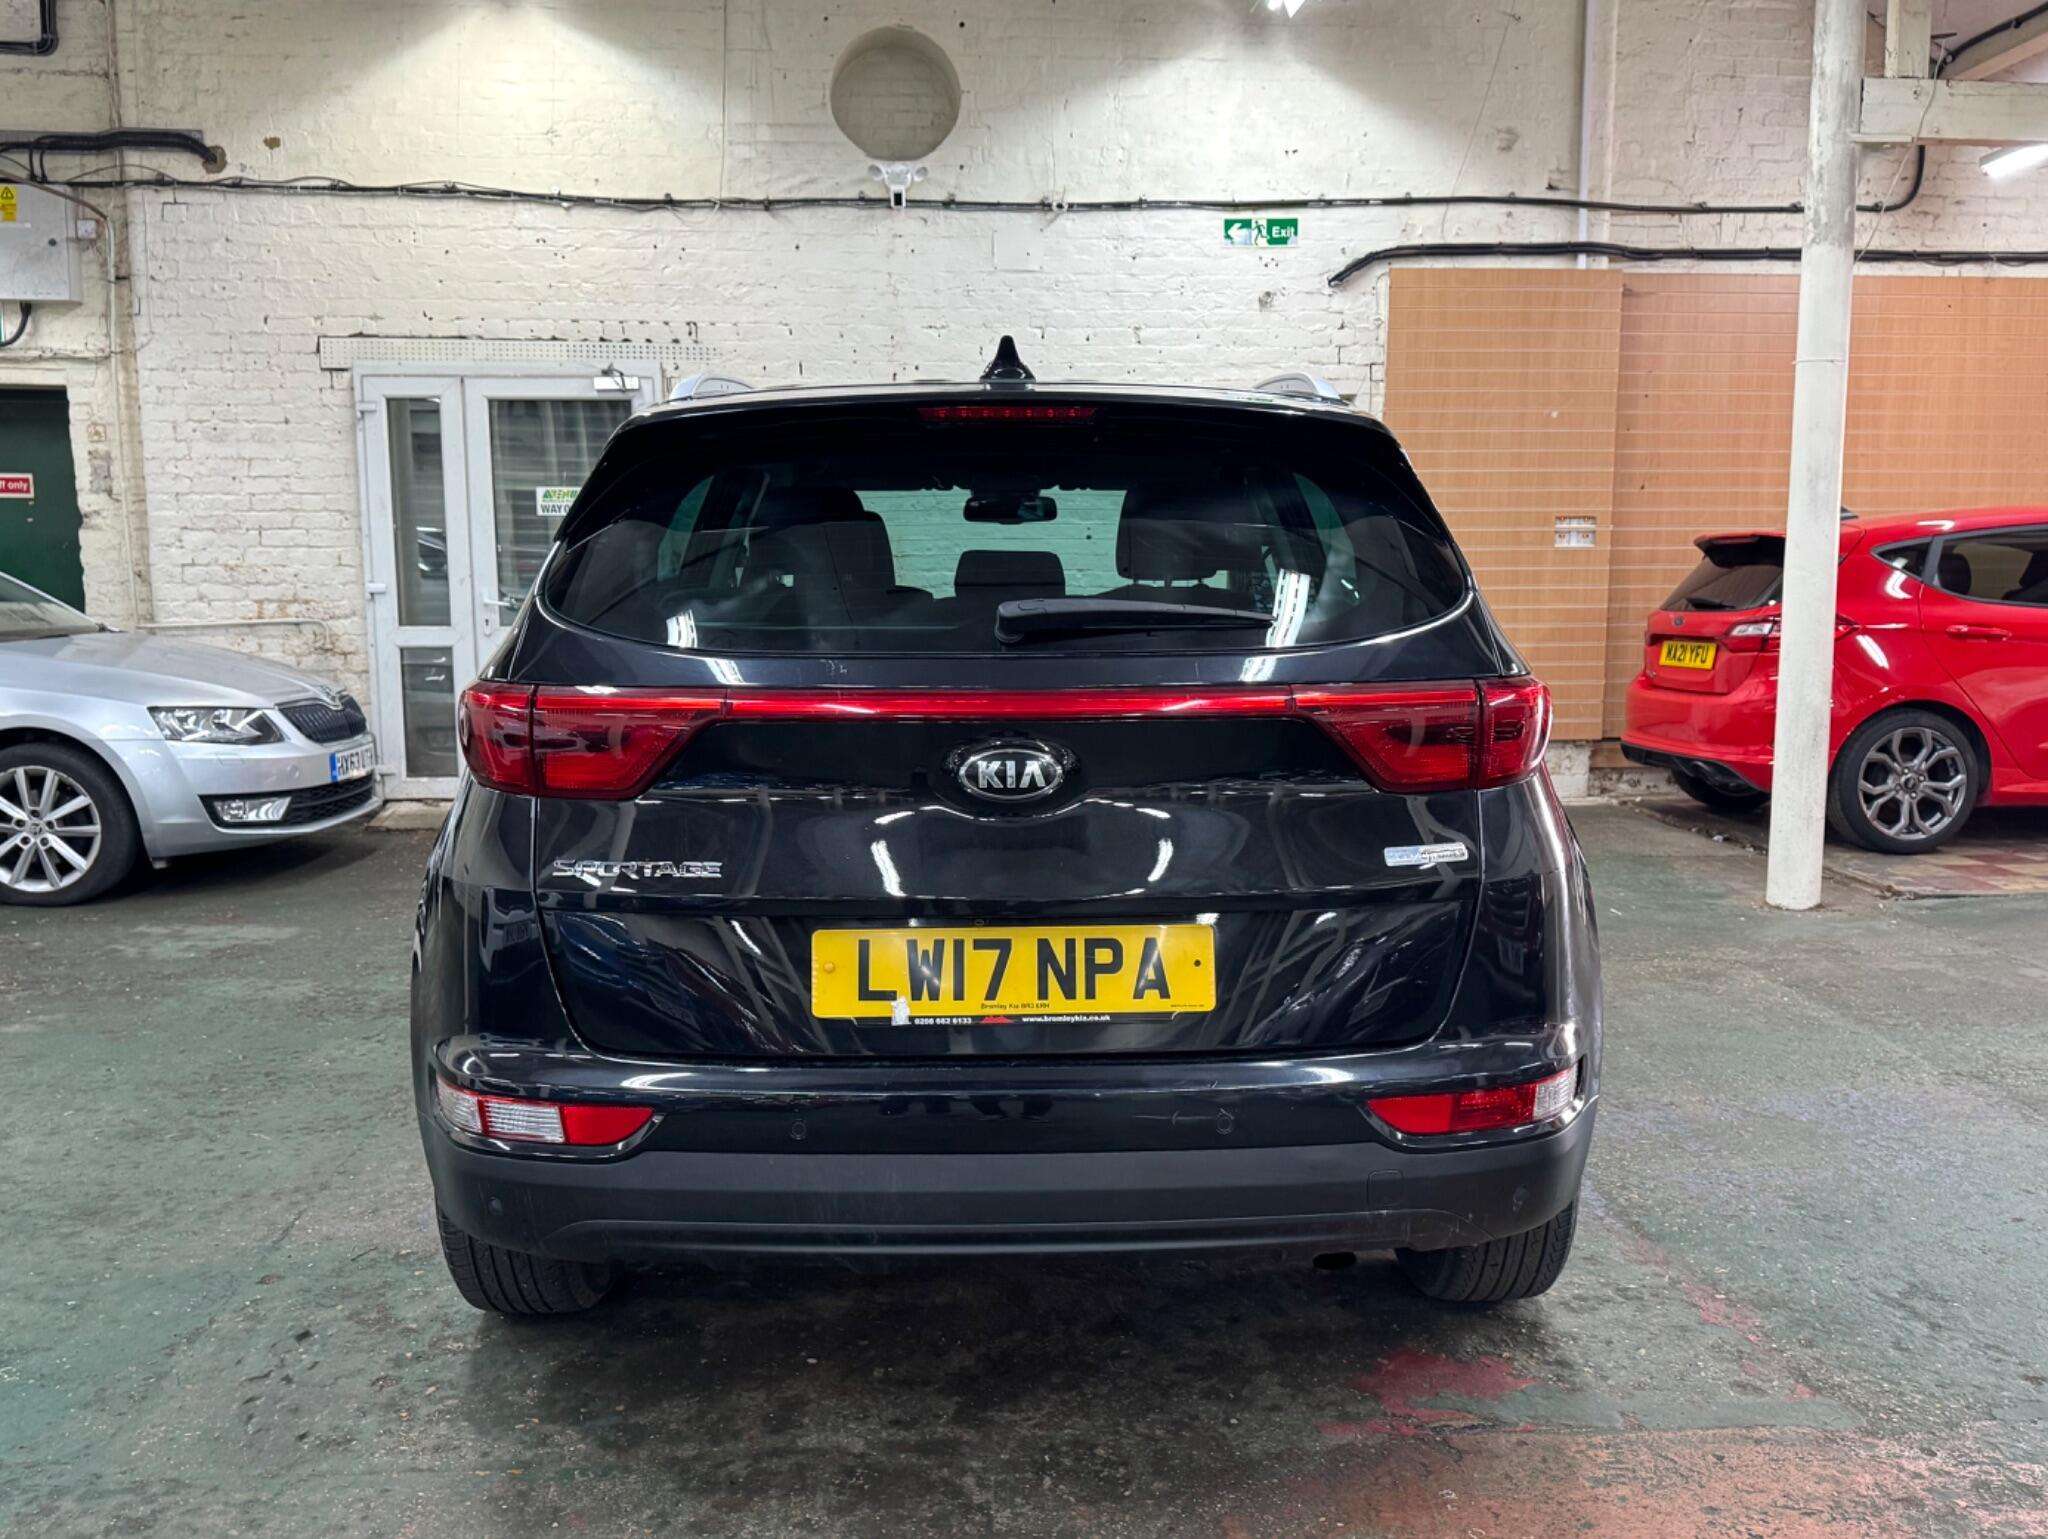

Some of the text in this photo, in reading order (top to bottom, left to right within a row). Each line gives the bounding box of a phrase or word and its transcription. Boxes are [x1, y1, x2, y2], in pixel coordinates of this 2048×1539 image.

[1271, 225, 1295, 238] Exit
[7, 480, 28, 491] only
[540, 503, 561, 514] WAY
[977, 760, 1046, 788] KIA
[552, 859, 723, 880] SPORTAGE
[857, 936, 1172, 1002] LW17 NPA
